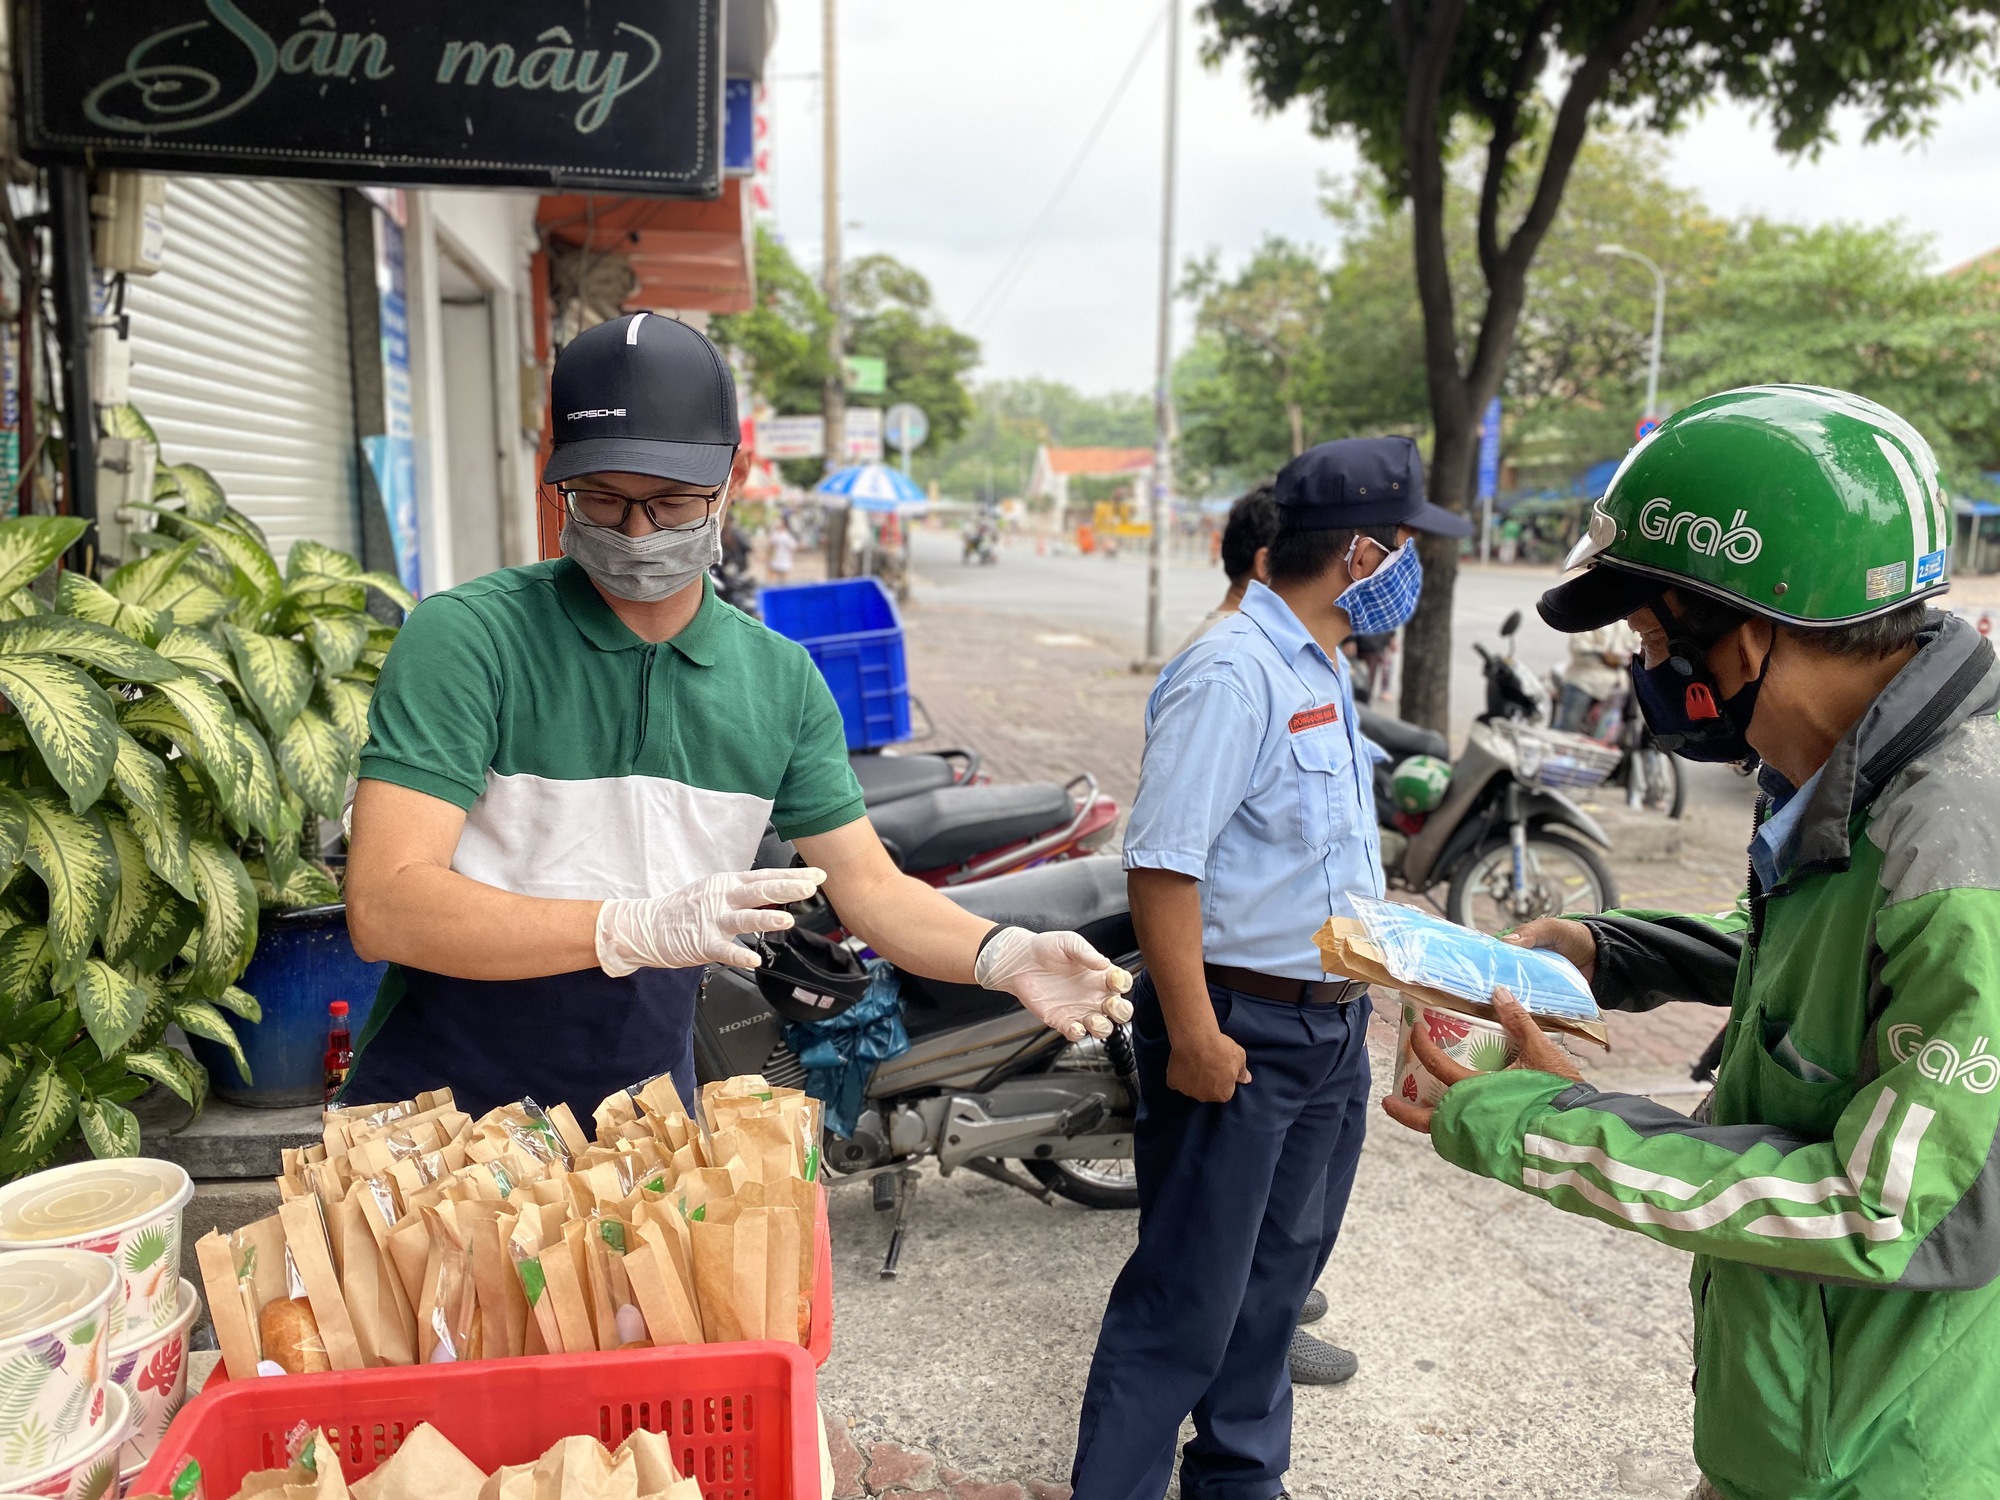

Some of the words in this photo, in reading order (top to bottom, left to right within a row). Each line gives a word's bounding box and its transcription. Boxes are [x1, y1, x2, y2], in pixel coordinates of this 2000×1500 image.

[437, 22, 661, 134] mây
[567, 409, 627, 421] PORSCHE
[1639, 497, 1763, 565] Grab
[718, 1011, 773, 1035] HONDA
